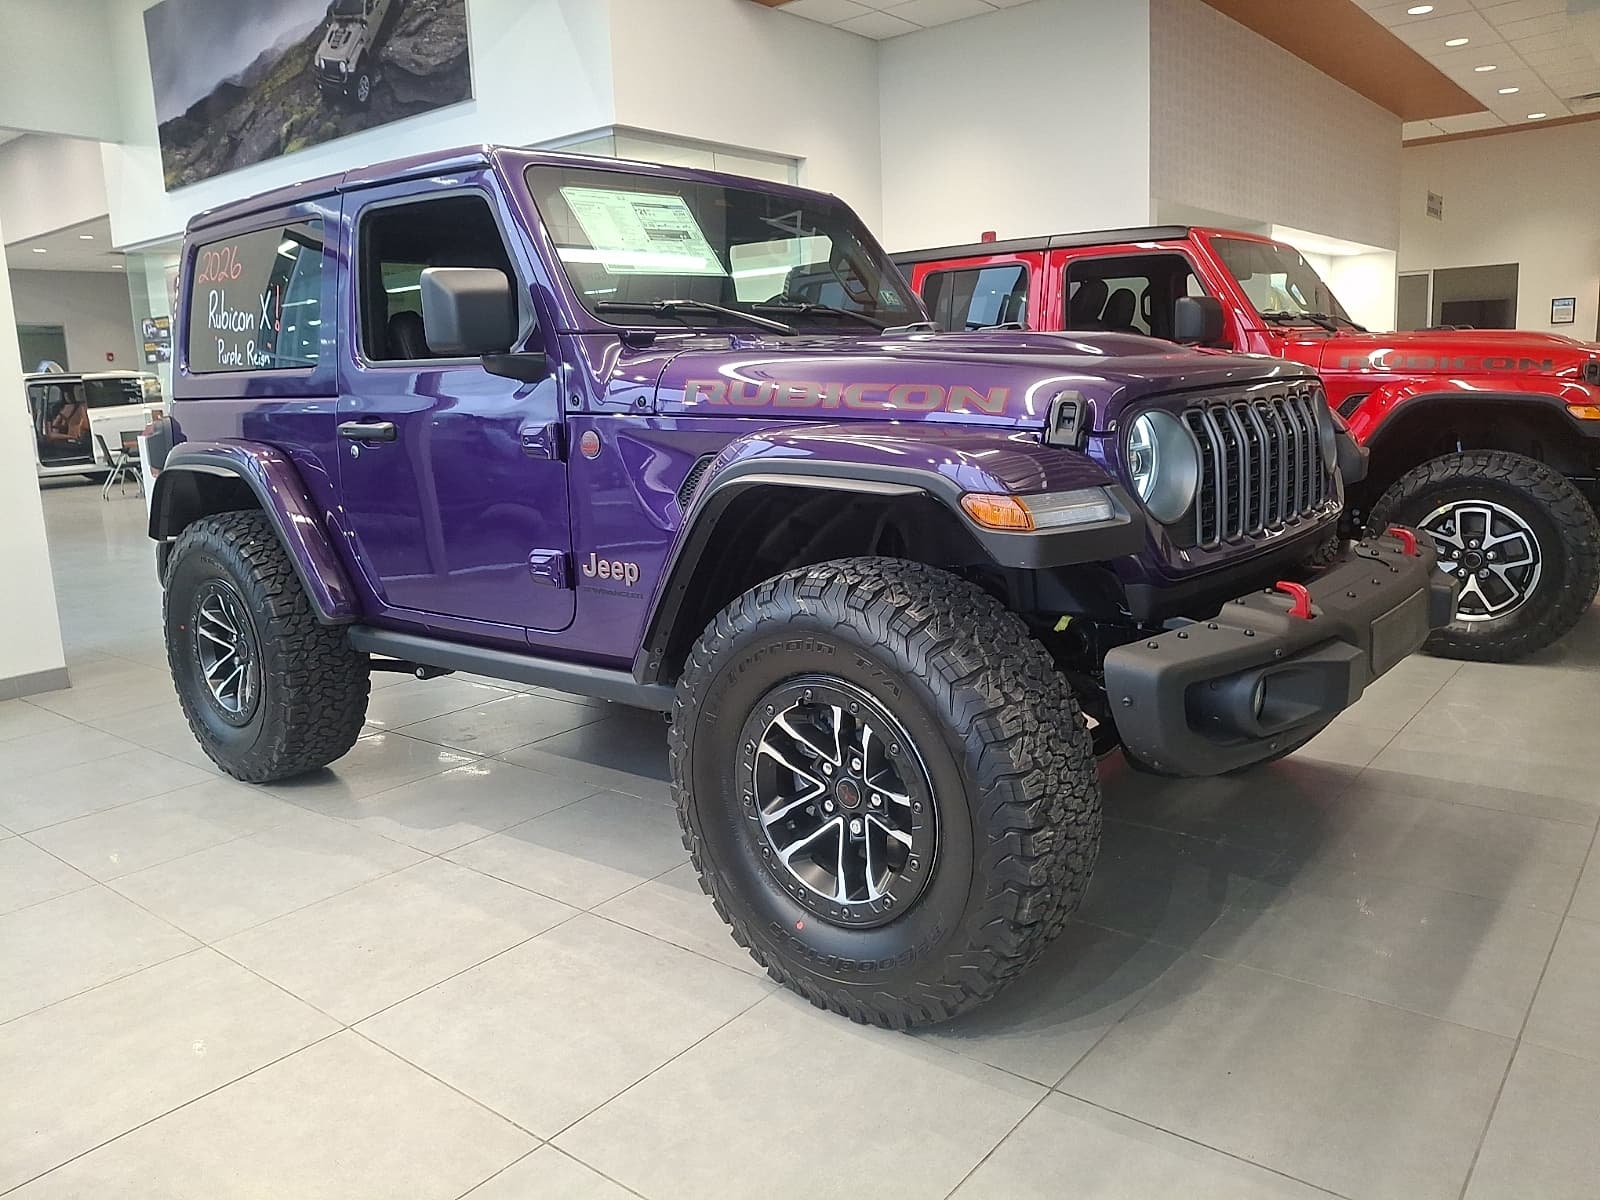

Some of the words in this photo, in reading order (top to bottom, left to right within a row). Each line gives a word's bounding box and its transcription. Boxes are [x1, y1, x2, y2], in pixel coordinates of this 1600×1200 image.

[199, 246, 242, 284] 2026
[208, 289, 254, 332] Rubicon
[217, 338, 244, 366] Purple
[246, 340, 271, 367] Reign
[683, 379, 1009, 414] RUBICON
[582, 552, 640, 587] Jeep
